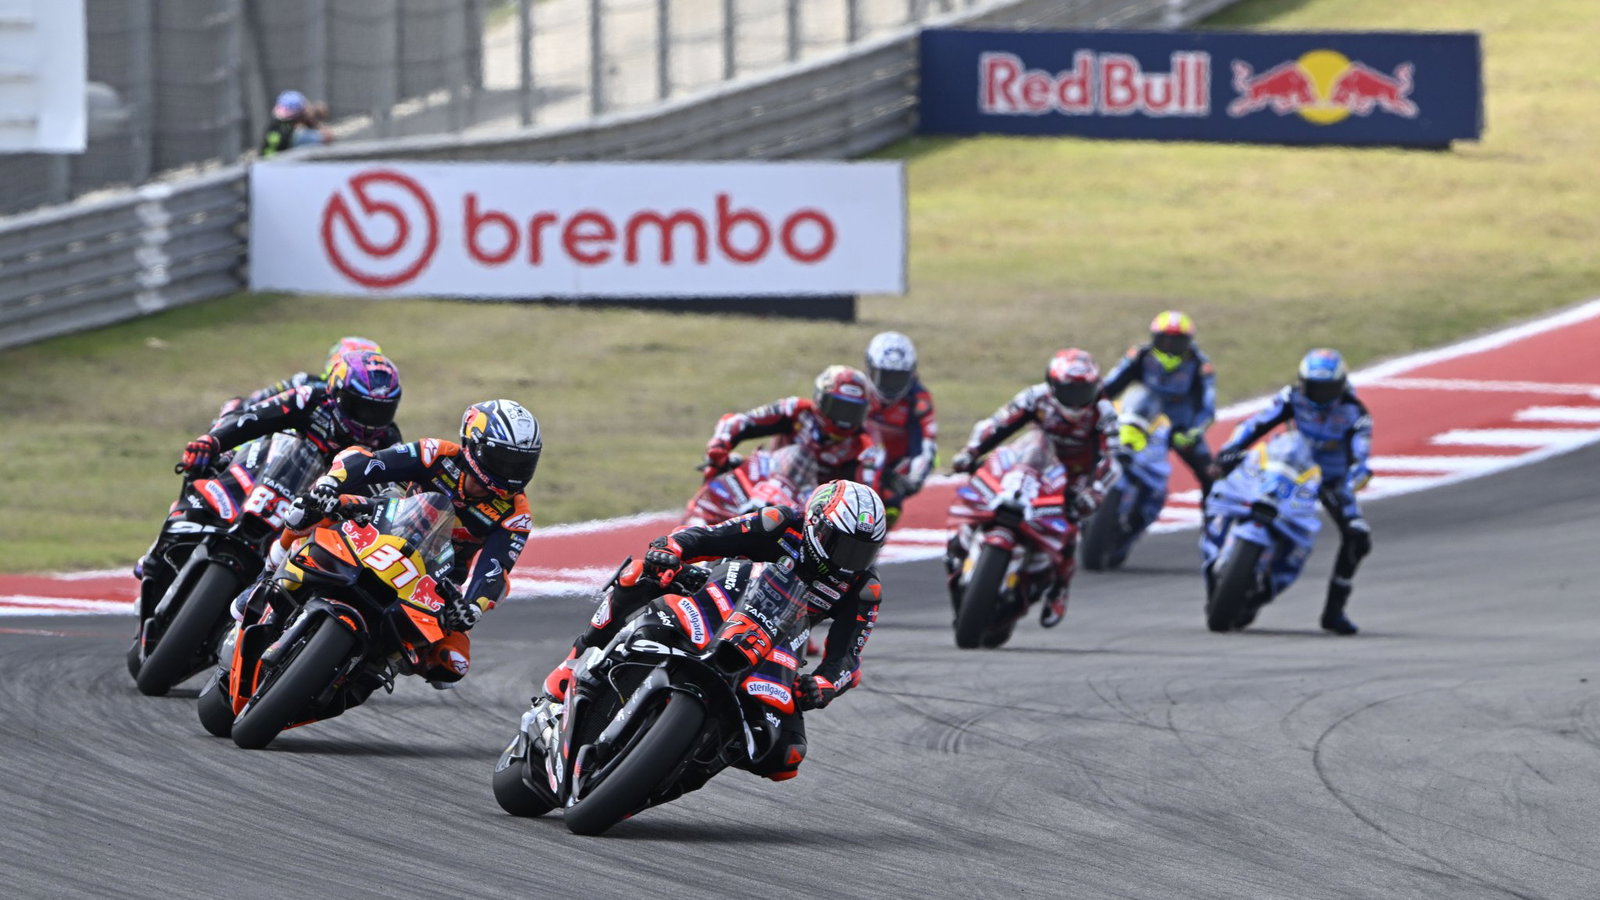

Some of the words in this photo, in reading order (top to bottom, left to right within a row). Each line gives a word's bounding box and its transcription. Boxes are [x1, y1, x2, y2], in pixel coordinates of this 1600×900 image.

[979, 50, 1096, 115] Red
[1099, 50, 1211, 117] Bull
[463, 192, 837, 266] brembo
[361, 543, 420, 590] 37
[656, 610, 674, 628] sky
[679, 599, 705, 642] sterilgarda
[744, 603, 779, 638] TARGA
[748, 682, 790, 703] sterilgarda
[765, 712, 782, 728] sky
